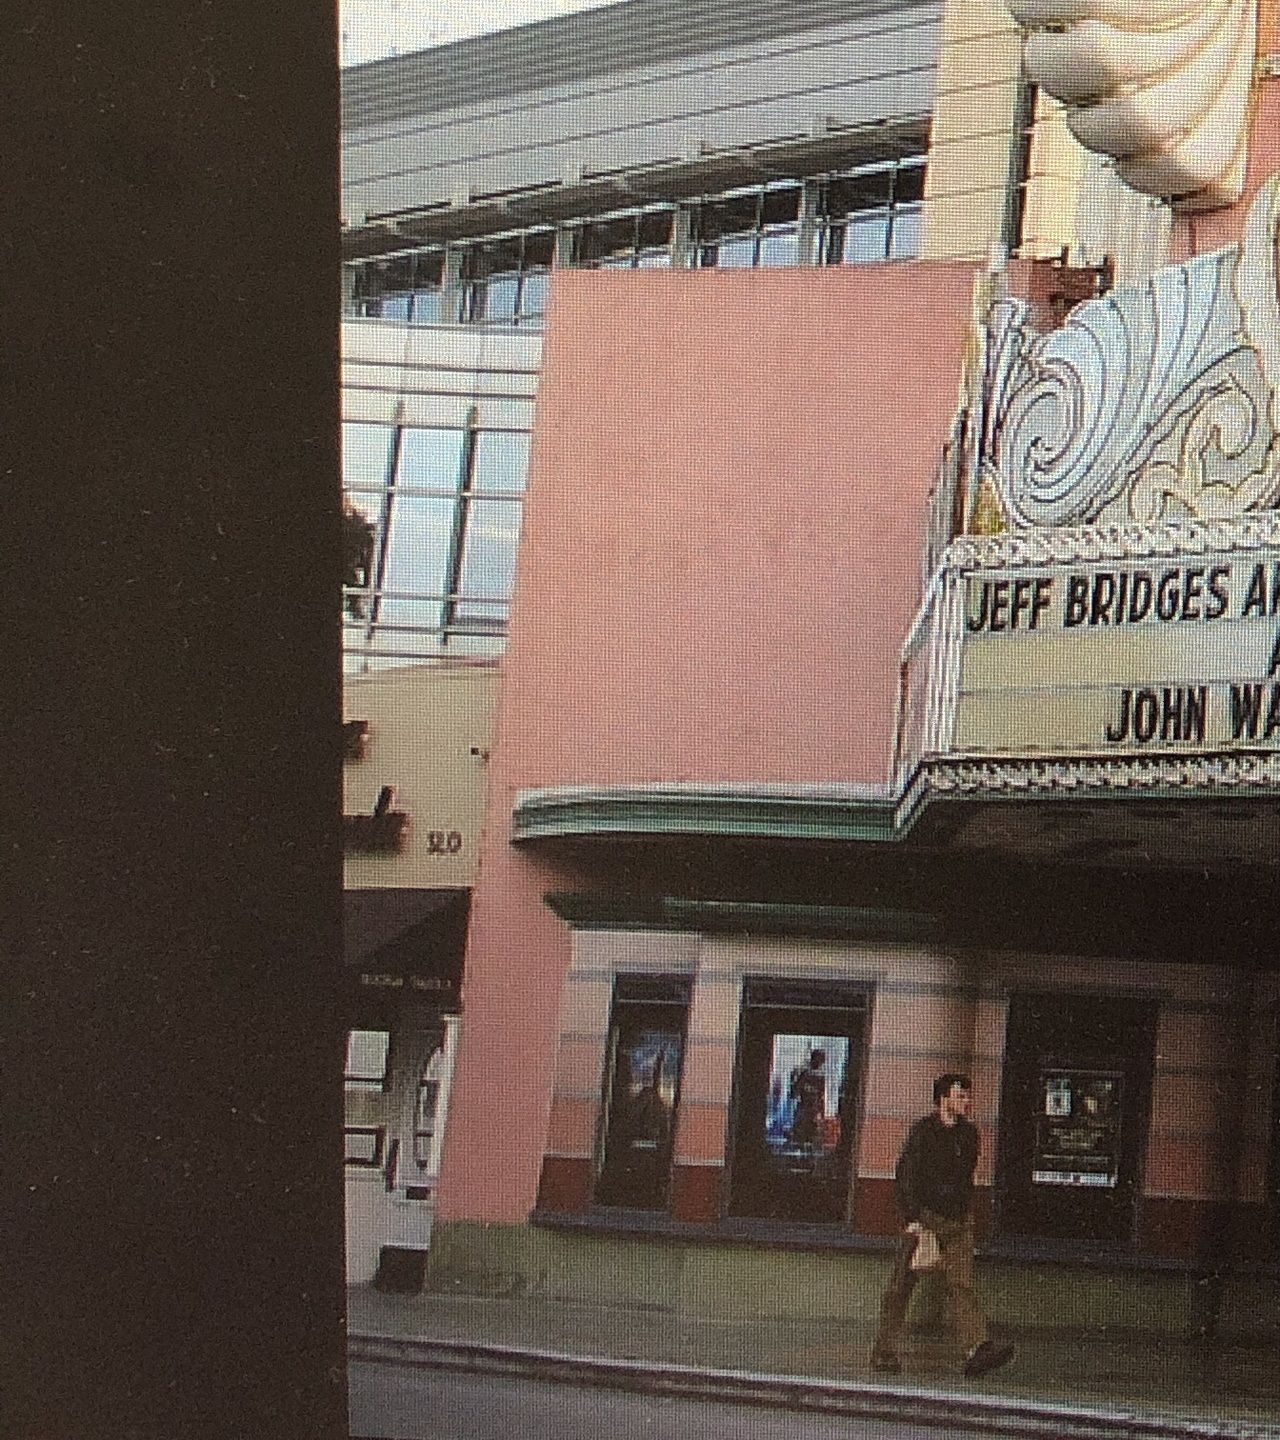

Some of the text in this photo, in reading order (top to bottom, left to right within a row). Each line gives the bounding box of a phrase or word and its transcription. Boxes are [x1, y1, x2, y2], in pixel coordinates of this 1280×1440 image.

[967, 575, 1053, 633] JEFF
[1064, 564, 1232, 628] BRIDGES
[1106, 684, 1209, 743] JOHN
